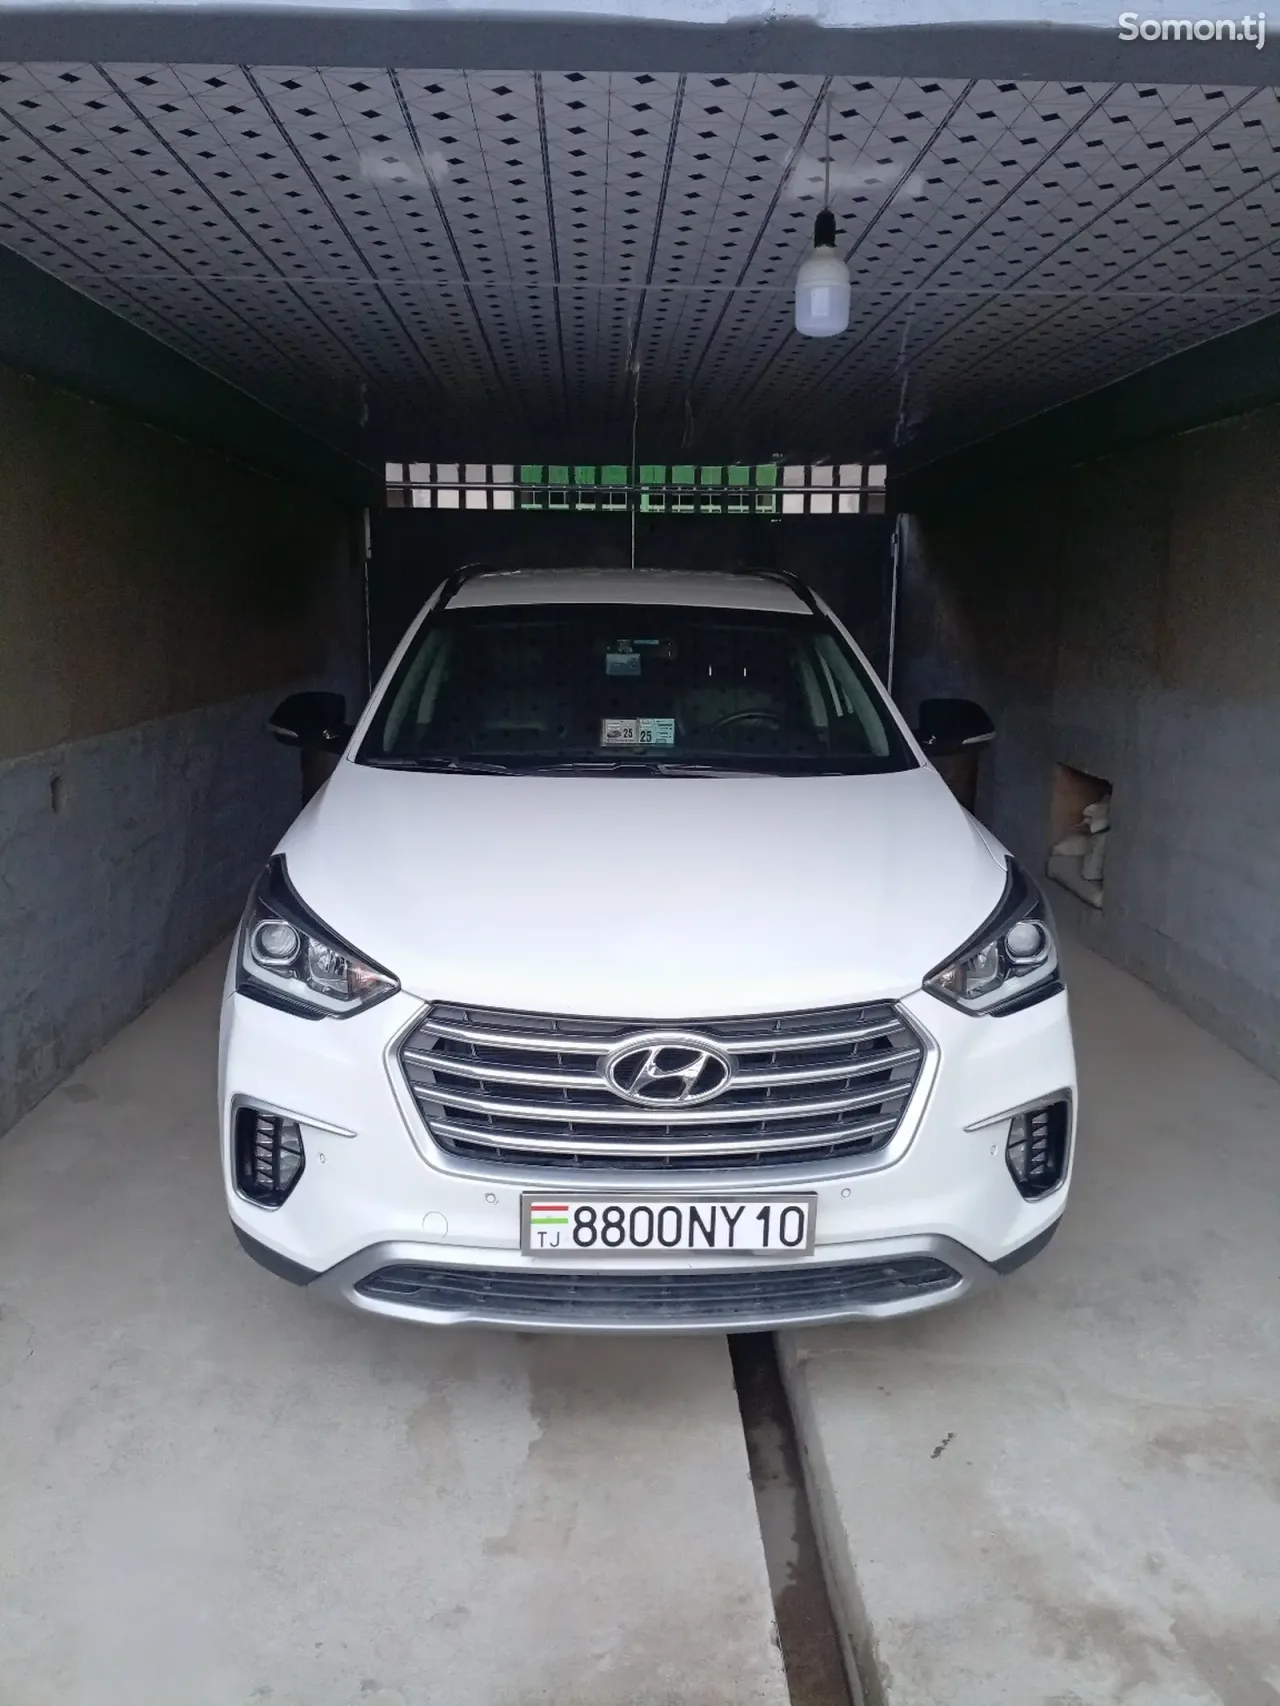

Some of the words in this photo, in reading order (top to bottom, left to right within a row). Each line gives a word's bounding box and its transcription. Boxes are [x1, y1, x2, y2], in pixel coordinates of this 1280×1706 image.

[623, 728, 633, 738] 25
[640, 731, 652, 742] 25
[537, 1231, 560, 1248] TJ
